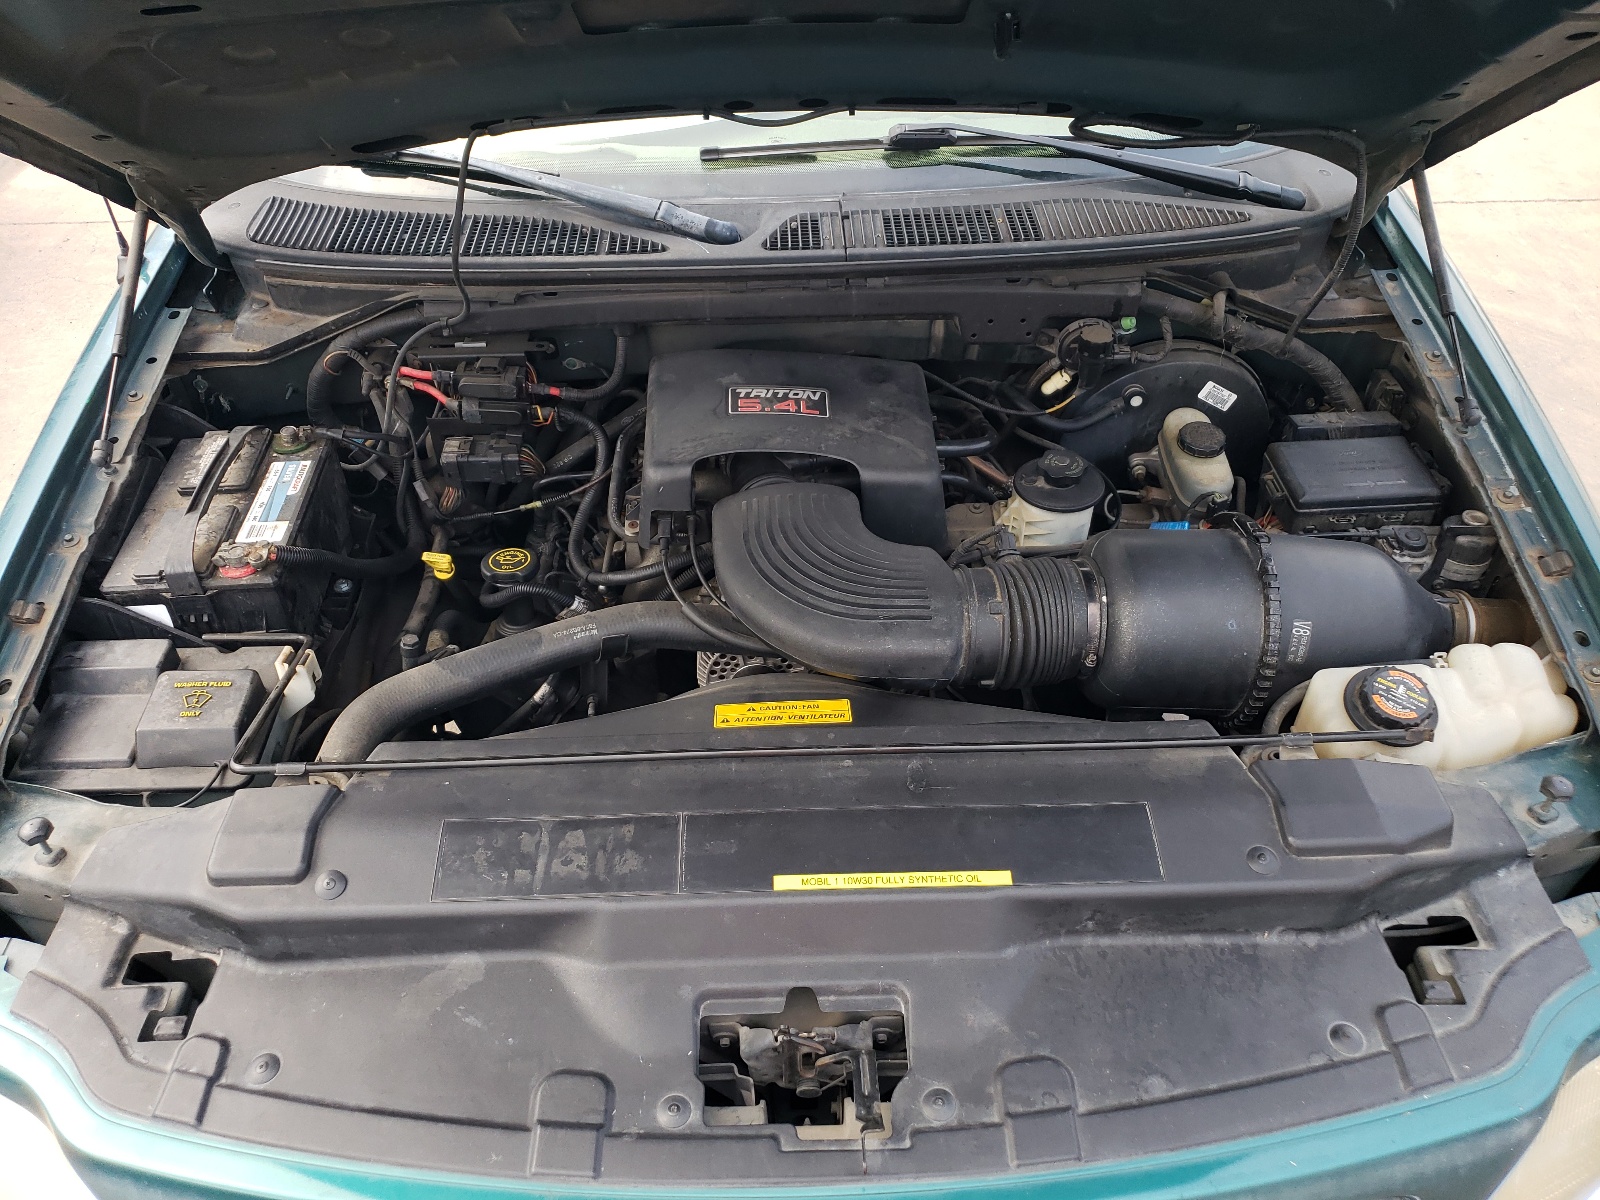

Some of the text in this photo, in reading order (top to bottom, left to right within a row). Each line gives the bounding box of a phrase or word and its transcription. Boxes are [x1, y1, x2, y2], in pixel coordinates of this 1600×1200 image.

[735, 388, 822, 400] TRITON
[738, 398, 820, 414] 5.4L
[1292, 621, 1311, 636] V8
[174, 680, 233, 689] WASHER FLUID
[801, 877, 832, 886] MOBIL
[843, 876, 873, 885] 10W30
[875, 876, 905, 885] FULLY
[908, 875, 964, 884] SYNTHETIC
[965, 874, 982, 883] OIL
